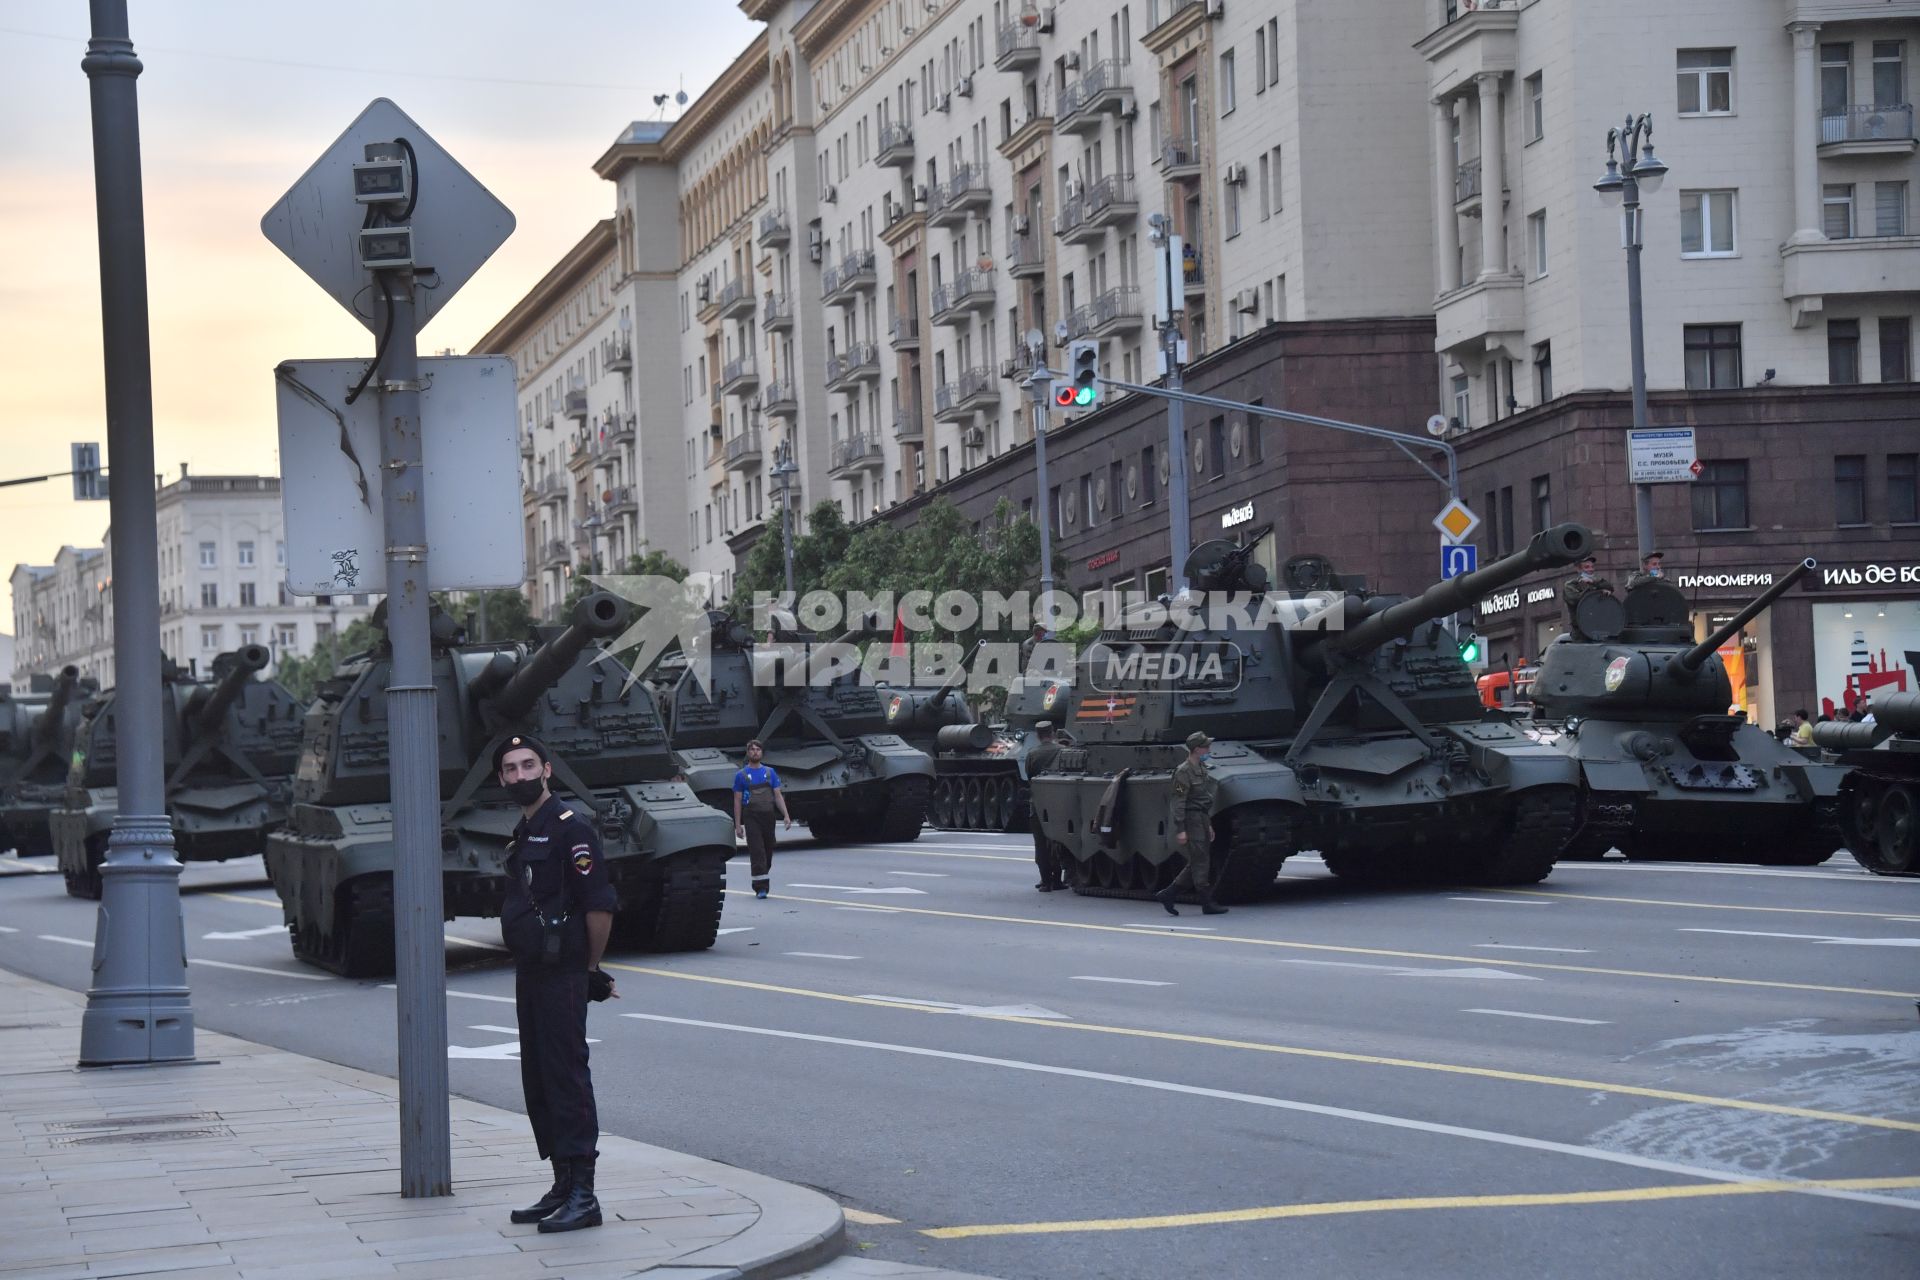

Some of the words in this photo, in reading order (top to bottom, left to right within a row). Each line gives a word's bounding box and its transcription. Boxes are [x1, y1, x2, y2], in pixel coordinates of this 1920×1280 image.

[1678, 573, 1772, 588] ПАРФЮМЕРИЯ
[1823, 568, 1862, 585] ИЛЬ
[1527, 588, 1555, 603] КОСМЕТИКА
